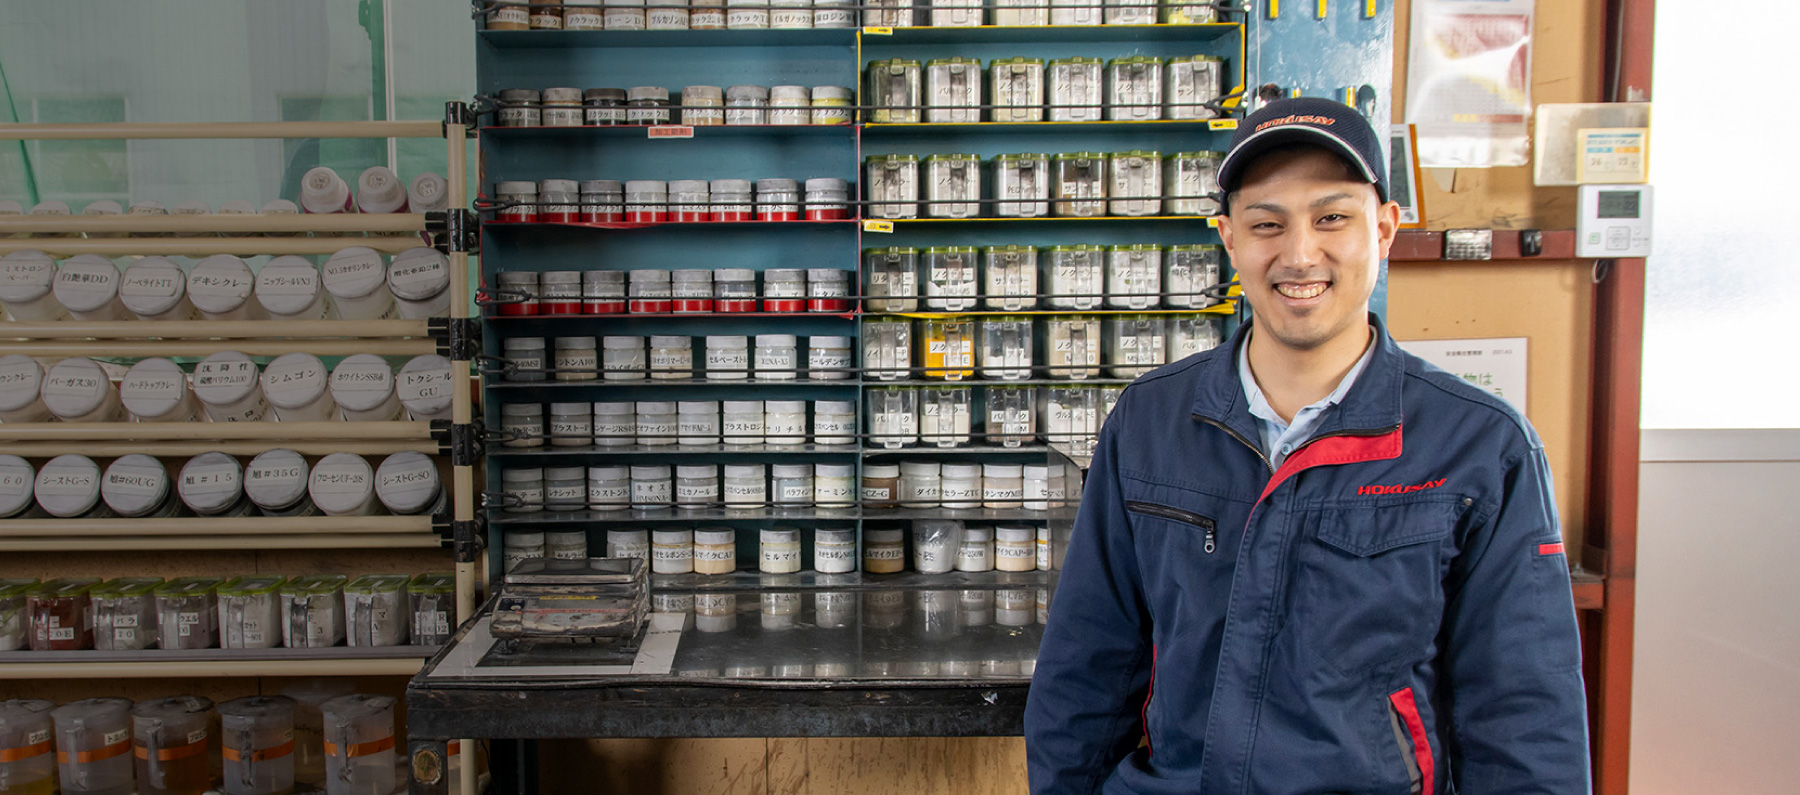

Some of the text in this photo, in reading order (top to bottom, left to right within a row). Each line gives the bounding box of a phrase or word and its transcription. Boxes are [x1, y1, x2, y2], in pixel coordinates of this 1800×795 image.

[1256, 115, 1335, 132] HOKUSAY
[192, 275, 249, 287] デキシクレー
[271, 369, 317, 385] シムゴン
[407, 373, 452, 385] トクシール
[419, 387, 438, 398] GU
[1356, 478, 1446, 496] HOKUSAY
